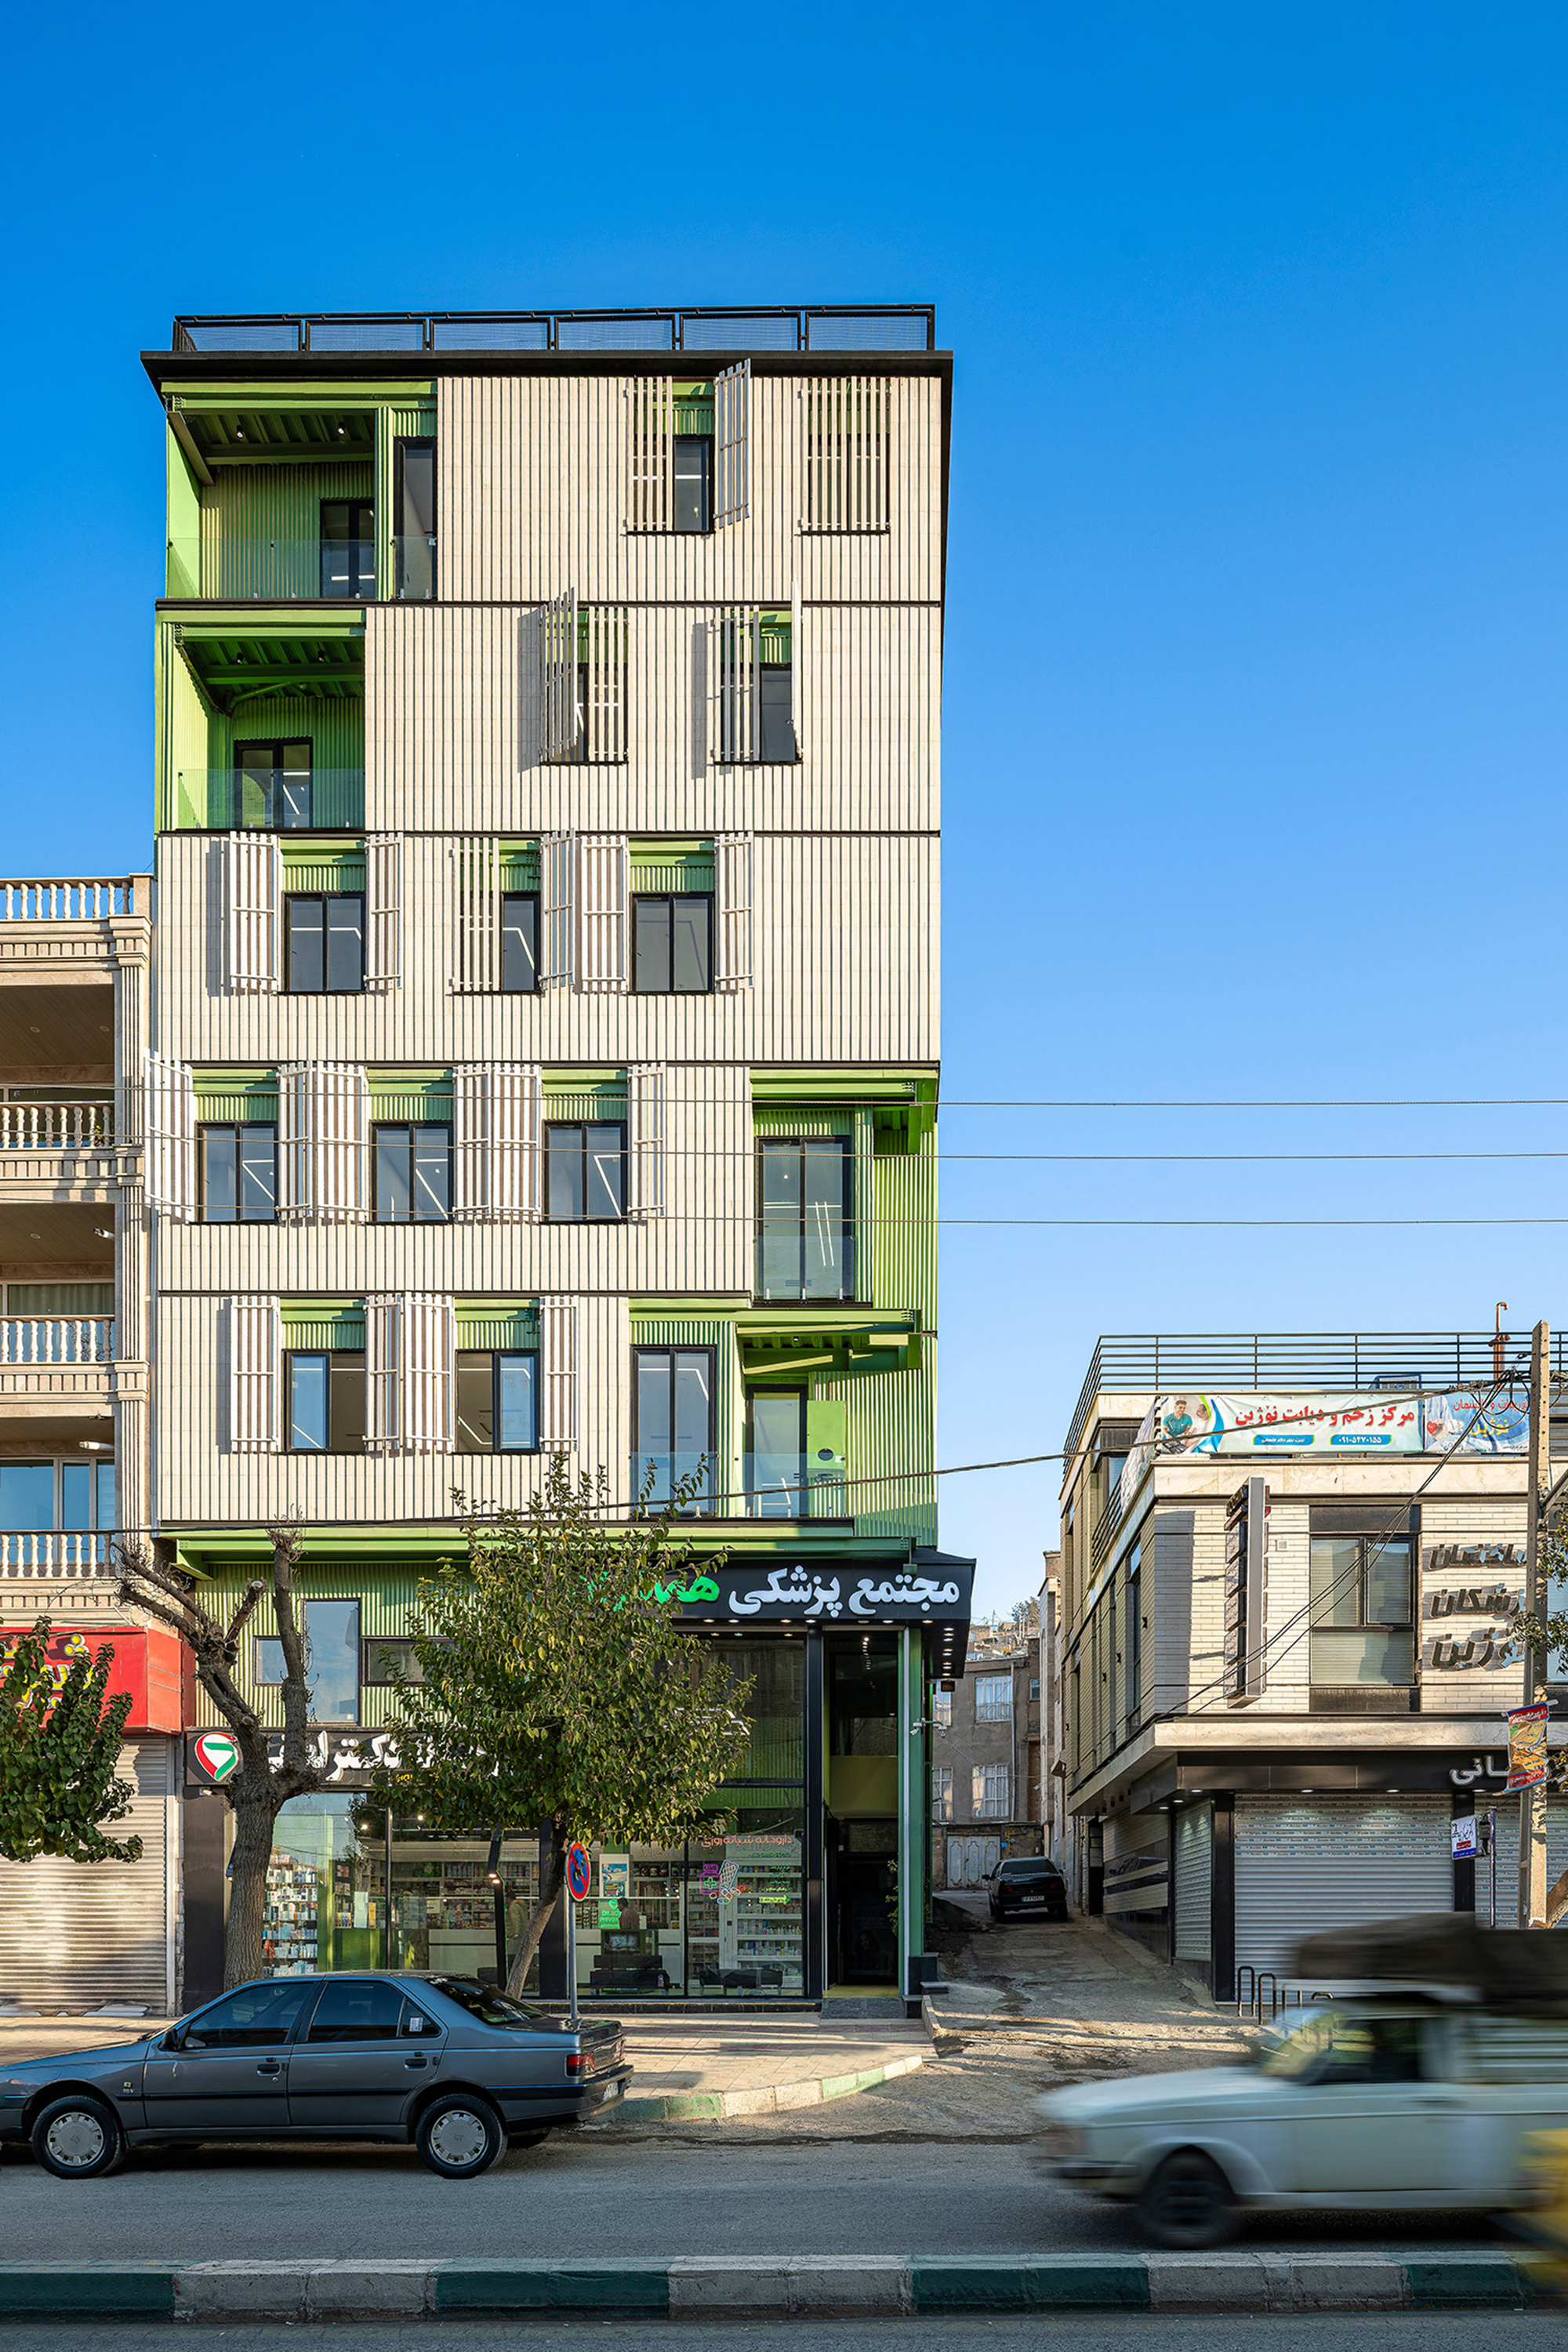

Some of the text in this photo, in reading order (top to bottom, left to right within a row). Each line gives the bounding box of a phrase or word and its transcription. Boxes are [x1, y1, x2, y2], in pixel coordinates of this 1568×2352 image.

[1283, 1406, 1324, 1425] دیابت
[1330, 1413, 1338, 1426] و
[1342, 1406, 1374, 1426] زخم
[1379, 1406, 1414, 1426] مرکز
[728, 1565, 843, 1617] پزشکی
[848, 1573, 960, 1615] مجتمع
[1430, 1583, 1526, 1618] زشکان
